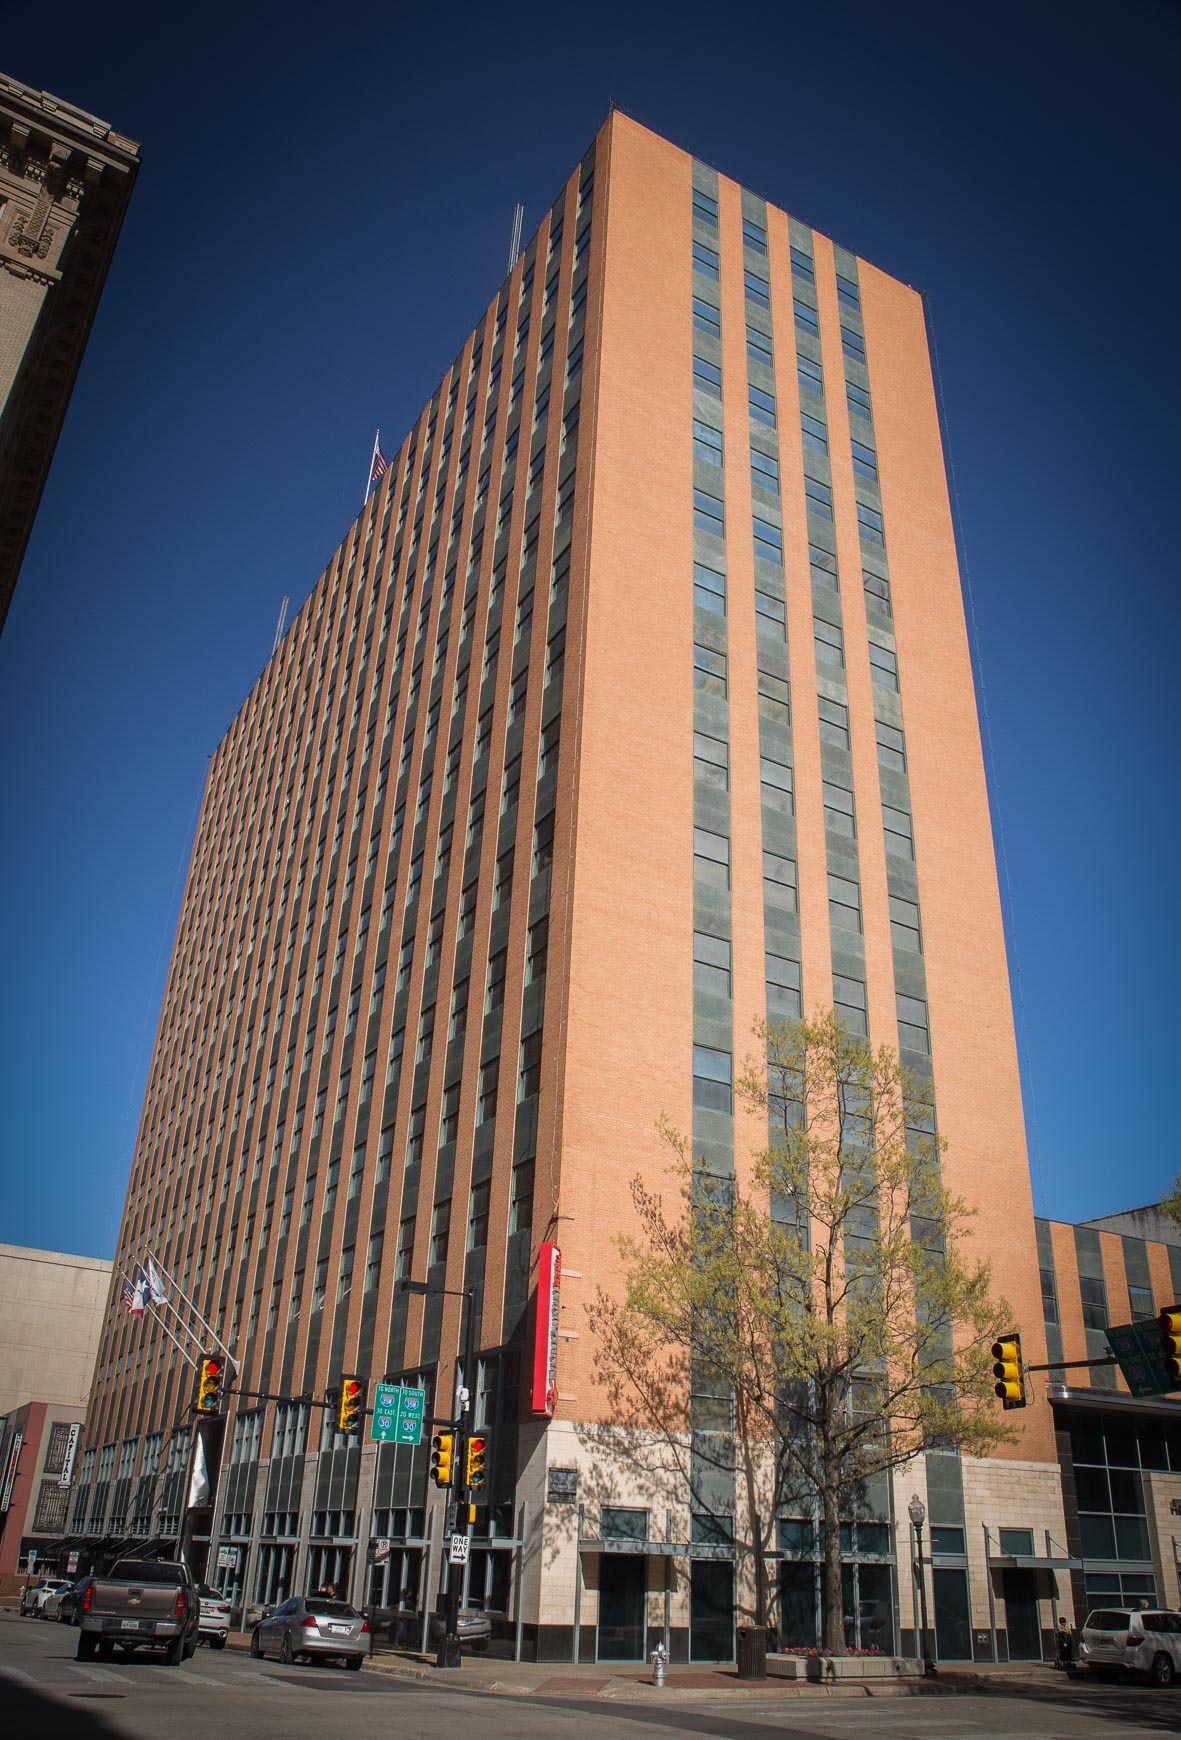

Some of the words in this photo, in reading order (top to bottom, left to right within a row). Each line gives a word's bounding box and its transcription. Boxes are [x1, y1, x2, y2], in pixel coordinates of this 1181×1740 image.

[63, 1429, 76, 1481] CAPITAL
[453, 1537, 468, 1546] ONE
[453, 1545, 468, 1553] WAY
